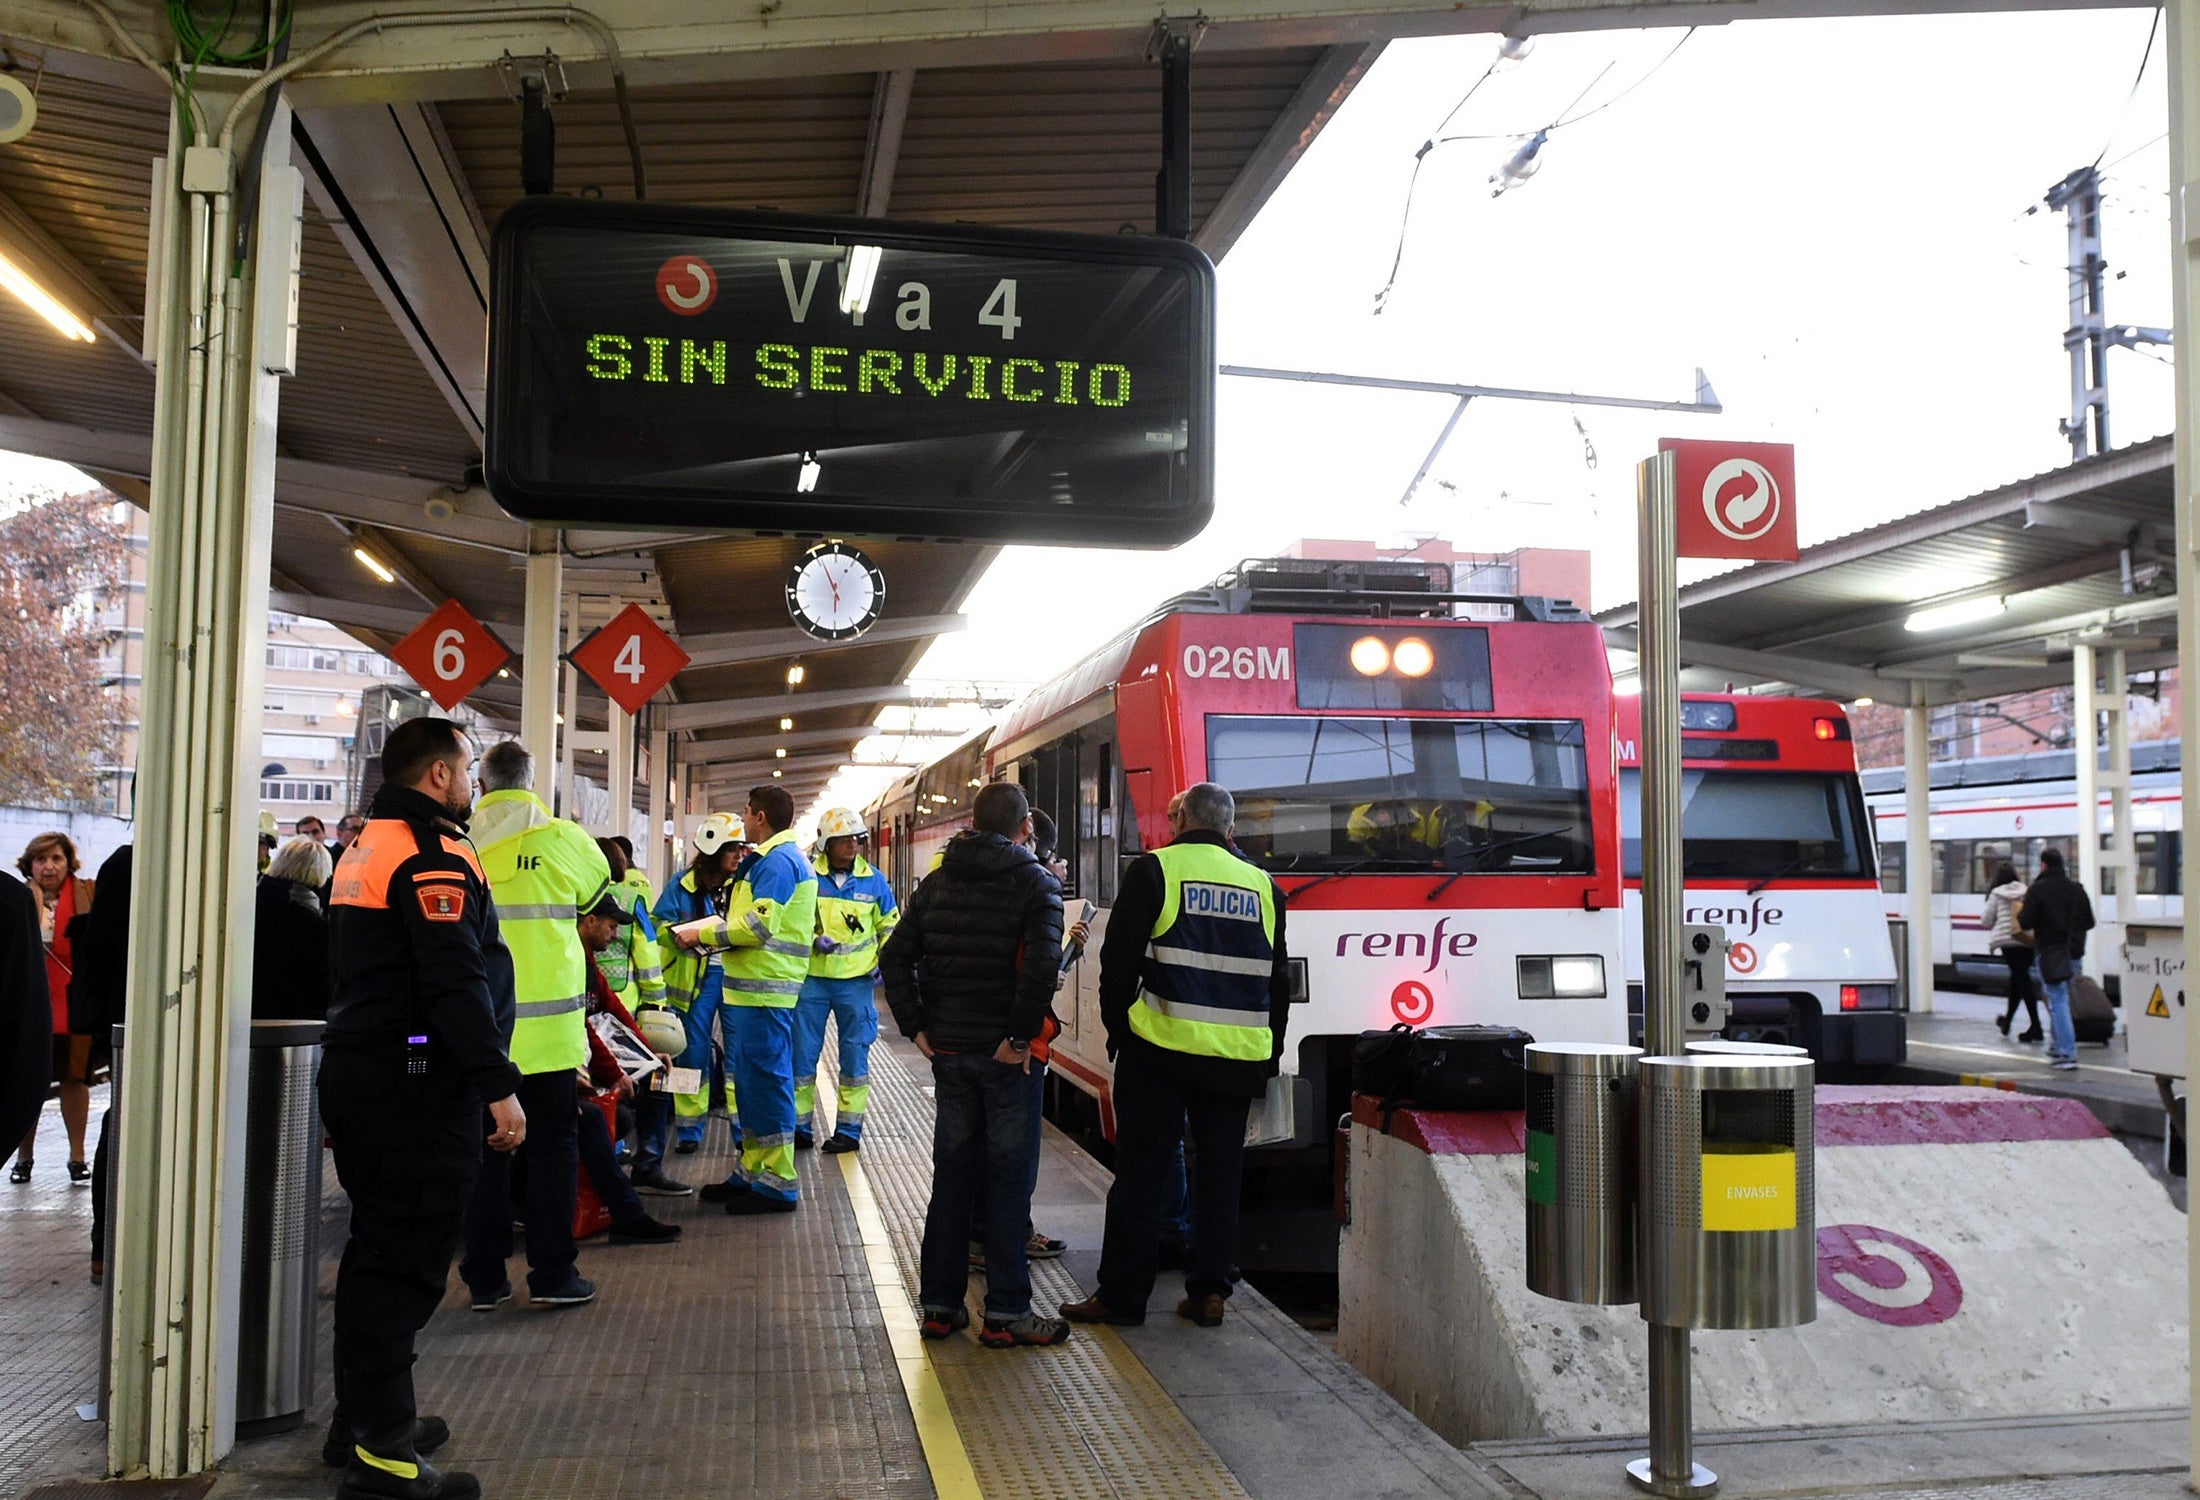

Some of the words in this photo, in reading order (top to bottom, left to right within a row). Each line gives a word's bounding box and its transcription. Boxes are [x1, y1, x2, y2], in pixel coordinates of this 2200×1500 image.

[777, 257, 932, 331] Va
[978, 278, 1022, 340] 4
[586, 333, 727, 385] SIN
[756, 343, 1131, 408] SERVICIO
[433, 628, 466, 682] 6
[613, 634, 646, 684] 4
[1183, 644, 1290, 681] 026M
[1187, 887, 1257, 918] POLICIA
[1686, 896, 1784, 936] renfe
[1335, 916, 1478, 974] renfe
[1727, 1185, 1779, 1200] ENVASES
